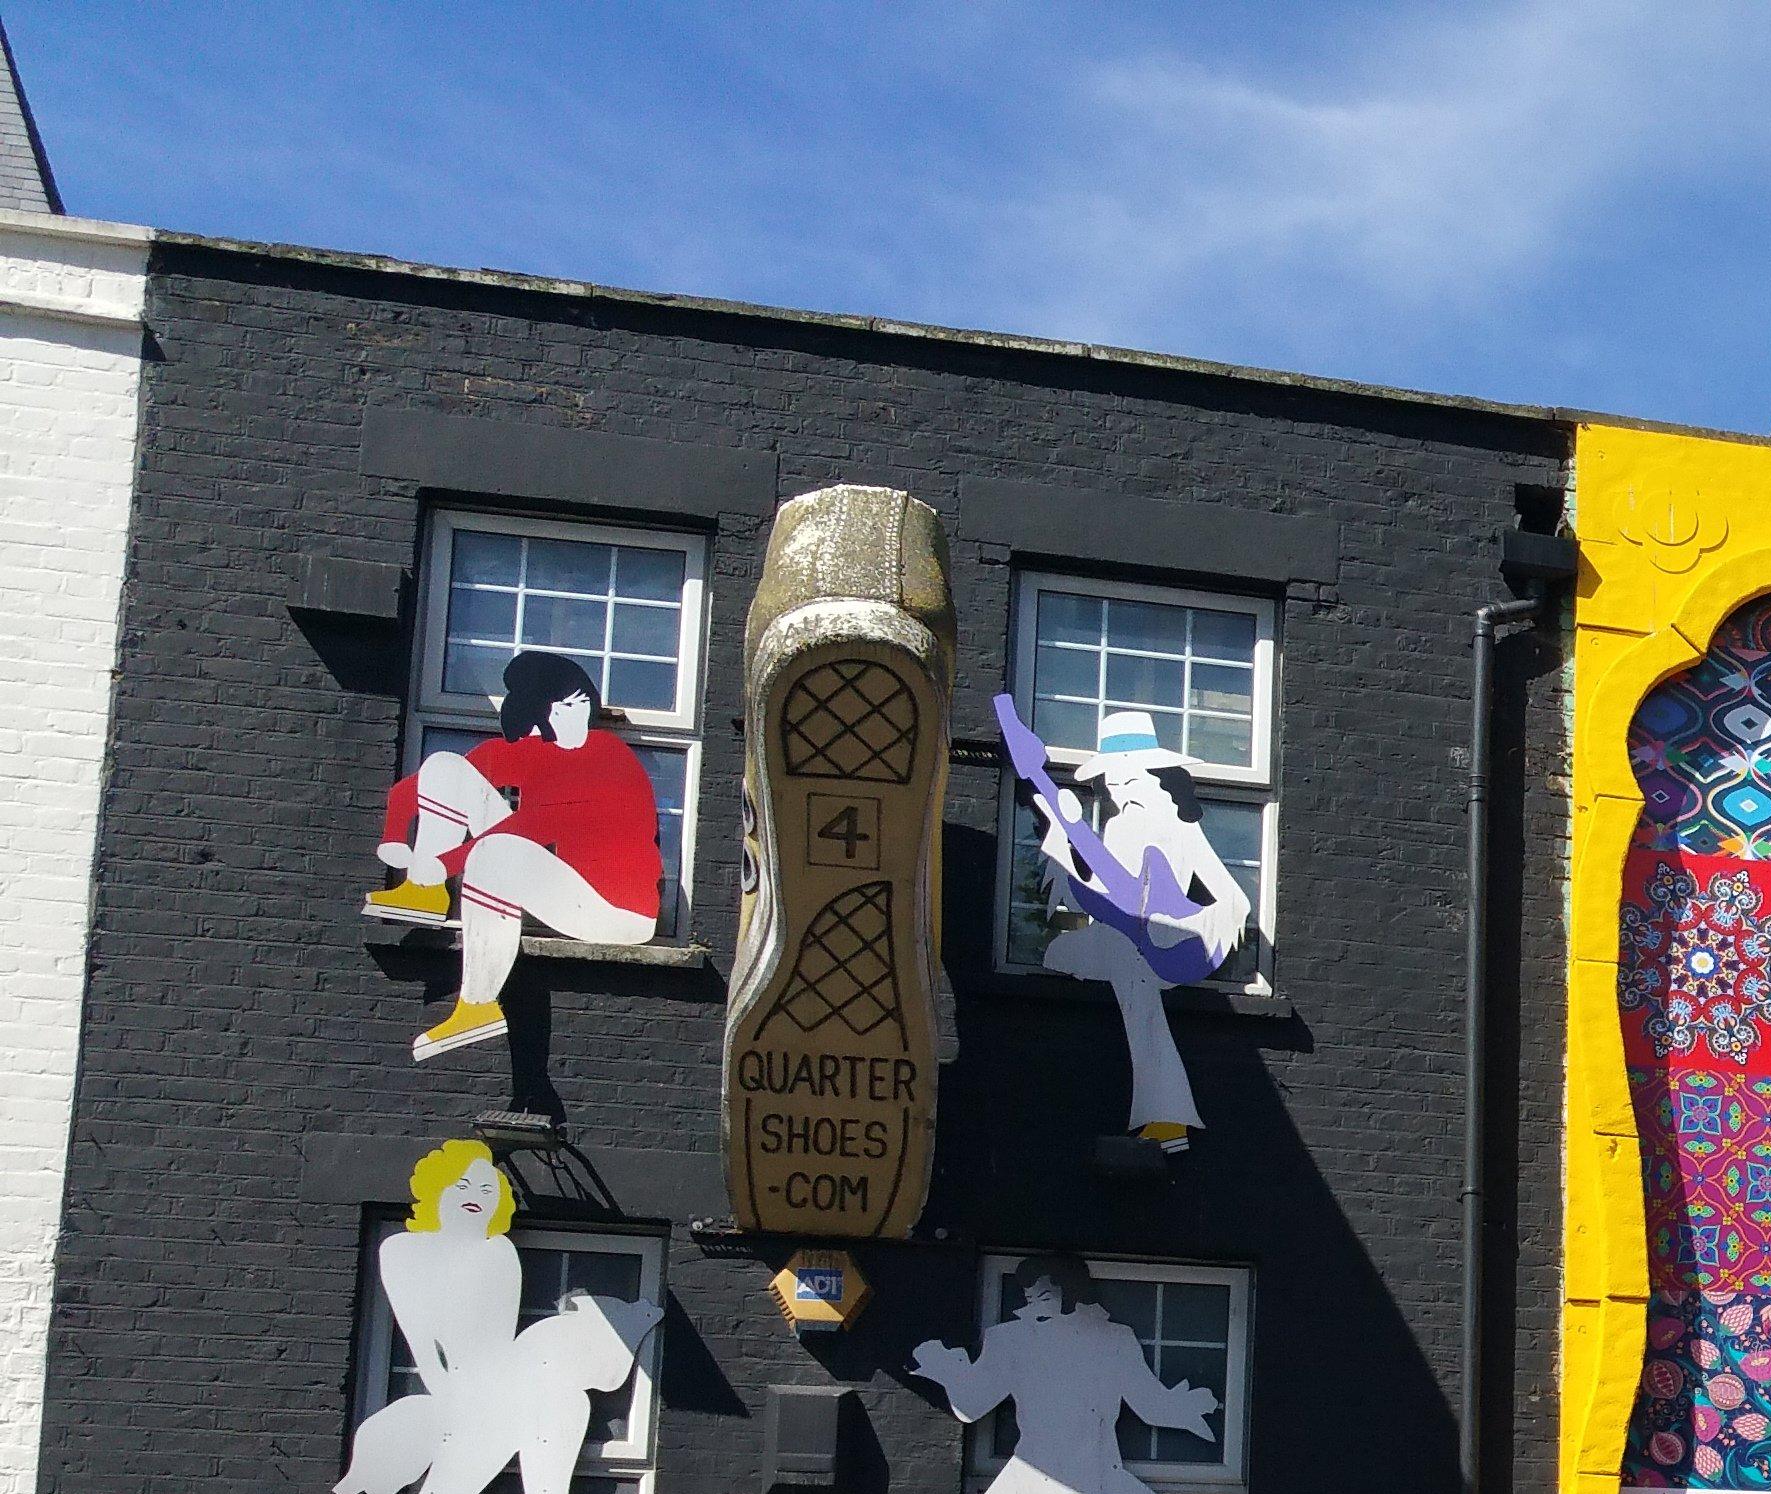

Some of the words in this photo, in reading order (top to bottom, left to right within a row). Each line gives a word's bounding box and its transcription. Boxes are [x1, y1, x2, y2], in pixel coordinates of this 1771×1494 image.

[816, 804, 871, 861] 4
[738, 1049, 917, 1102] QUARTER
[760, 1112, 888, 1159] SHOES
[797, 1275, 837, 1295] ADT
